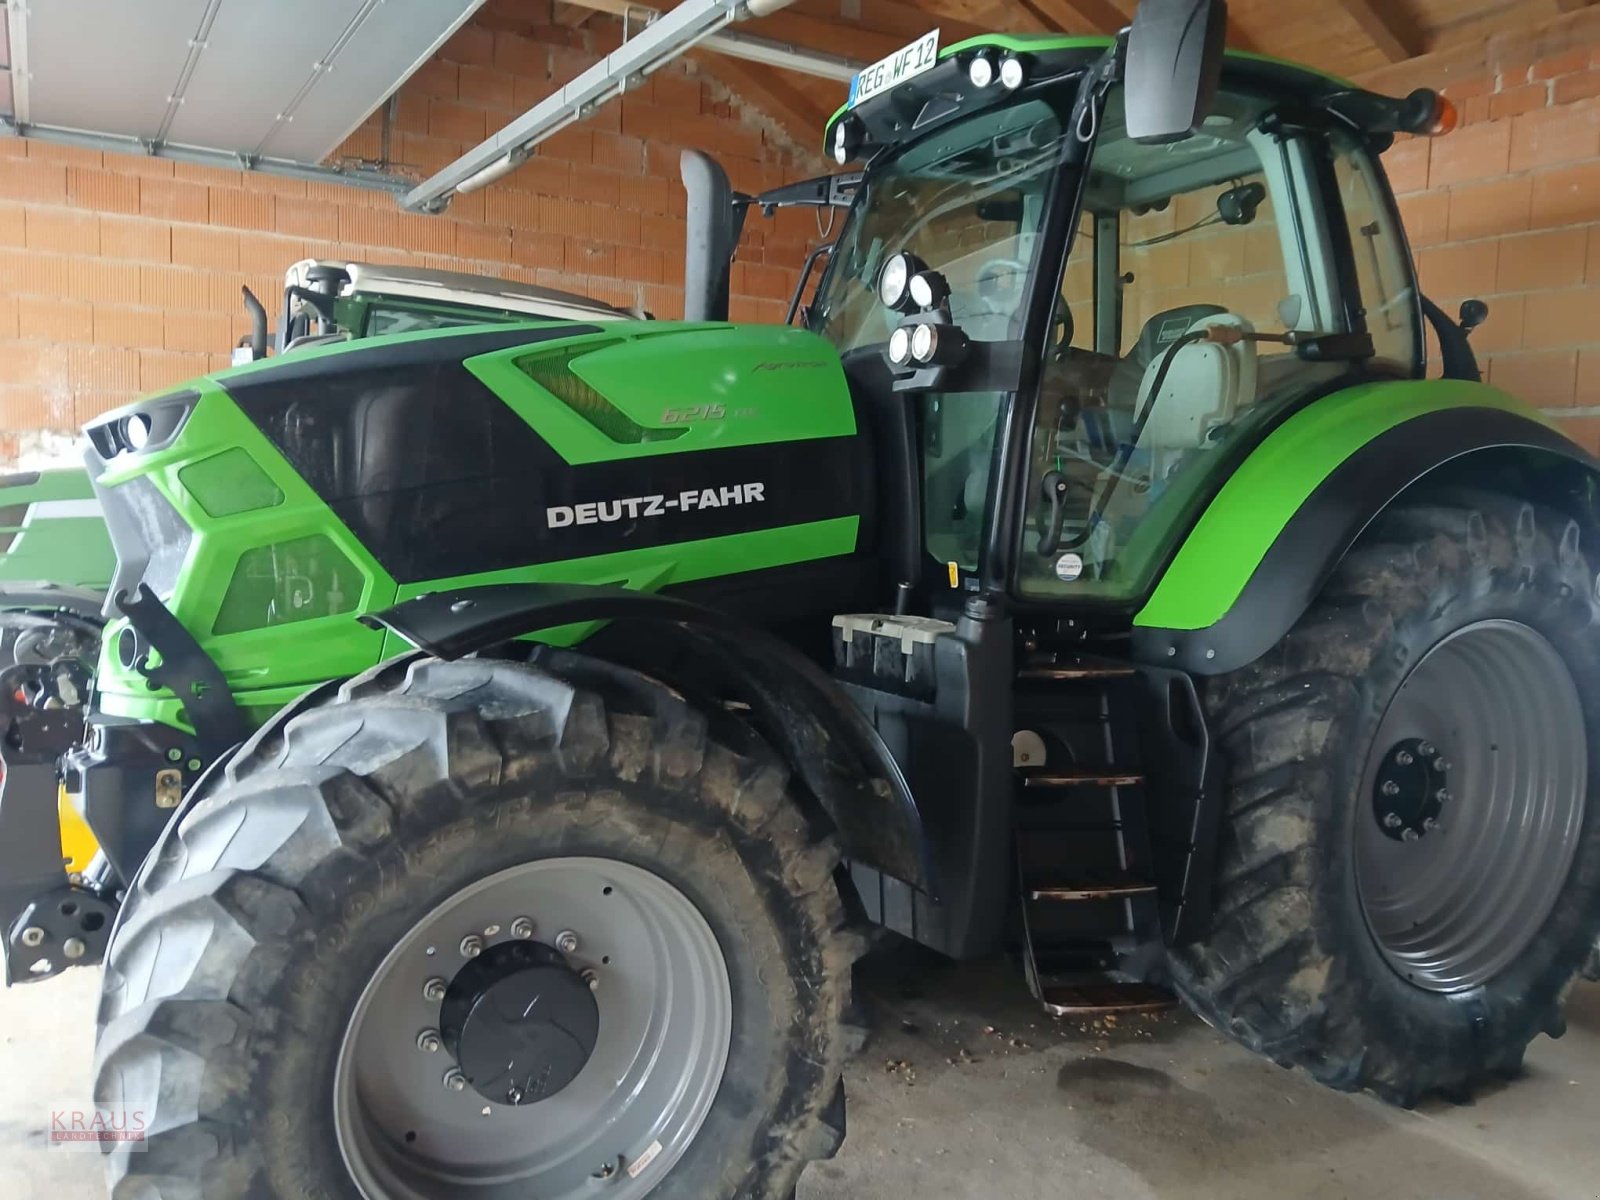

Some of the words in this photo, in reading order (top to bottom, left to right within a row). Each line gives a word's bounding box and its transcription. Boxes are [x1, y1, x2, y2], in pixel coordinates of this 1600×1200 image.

[856, 64, 885, 98] REG
[892, 48, 914, 80] WF
[914, 37, 935, 70] 12
[660, 403, 727, 424] 6215
[546, 482, 765, 529] DEUTZ-FAHR
